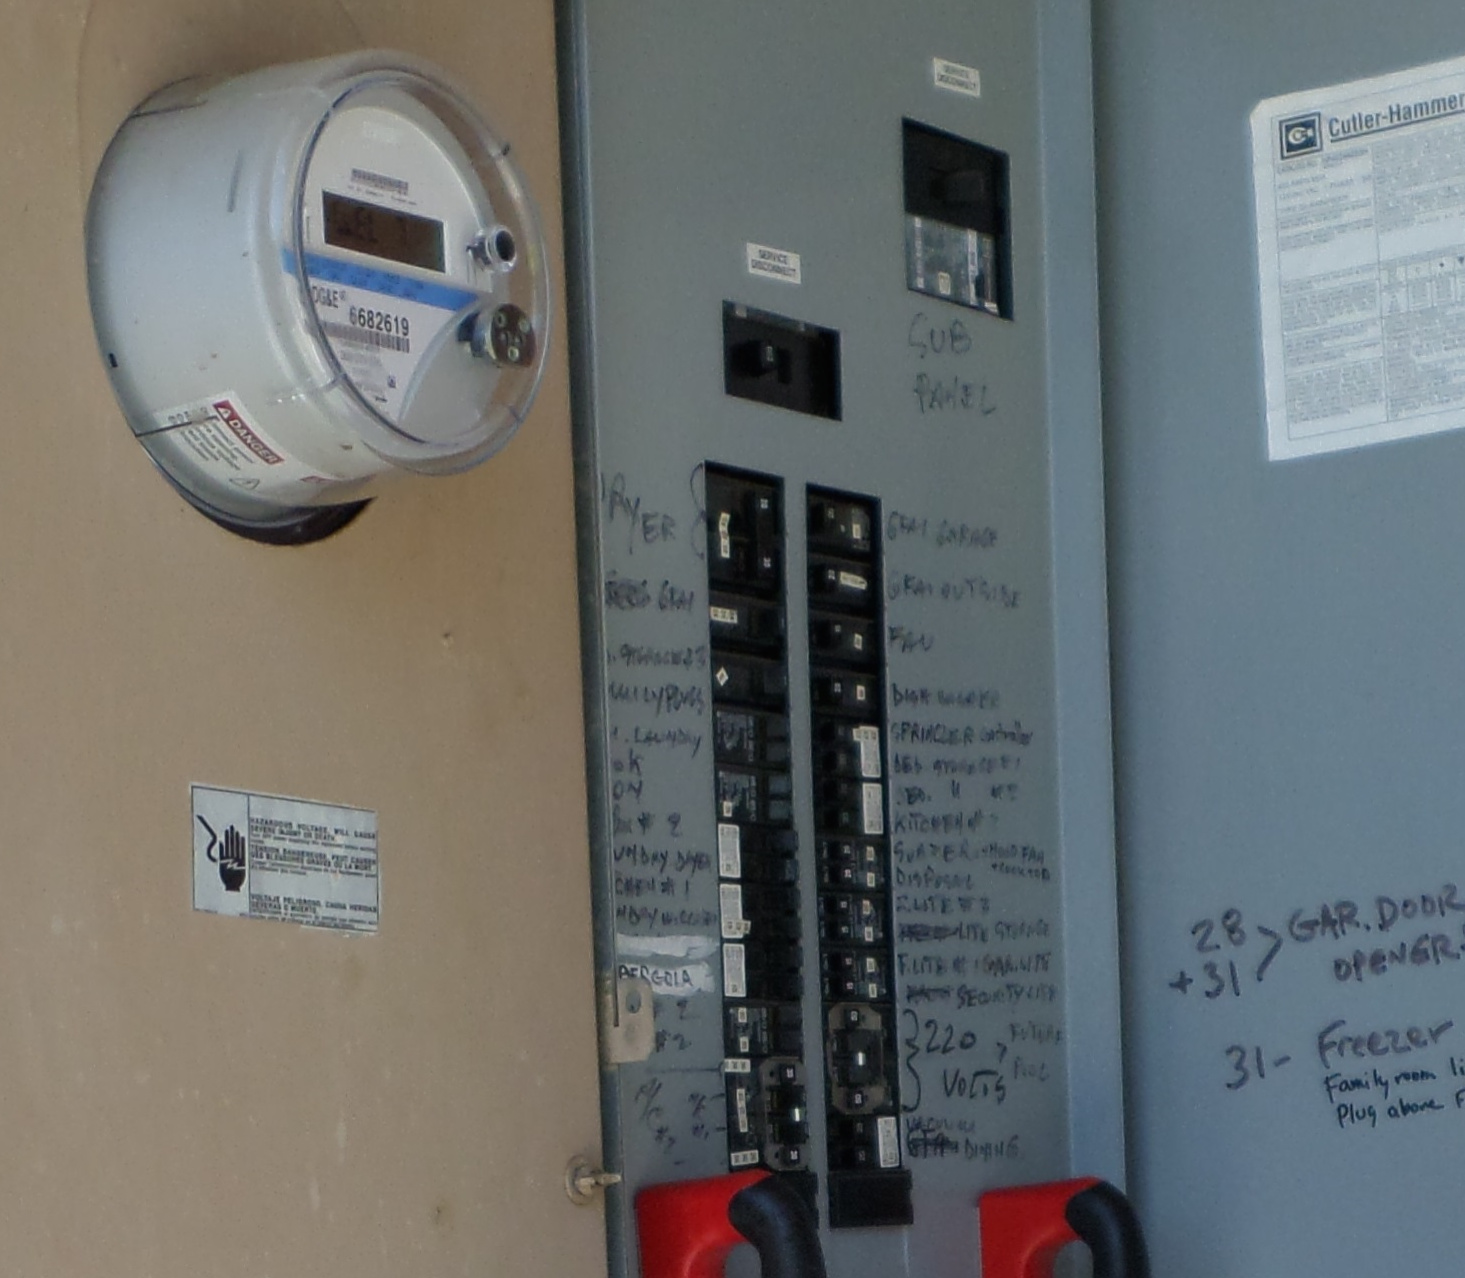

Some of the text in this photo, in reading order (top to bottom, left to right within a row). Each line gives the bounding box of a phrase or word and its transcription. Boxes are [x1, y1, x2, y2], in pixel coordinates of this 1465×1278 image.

[1328, 93, 1465, 138] Cutler-Hammer
[349, 305, 409, 336] 6682619
[228, 419, 280, 464] DANGER
[1191, 908, 1247, 953] 28
[924, 1018, 977, 1055] 220
[1317, 1019, 1454, 1069] Freezer
[943, 1068, 1007, 1106] VOLTS
[1324, 1067, 1390, 1103] Family
[1394, 1069, 1437, 1086] room
[1336, 1101, 1377, 1128] Plug
[1387, 1098, 1445, 1119] above
